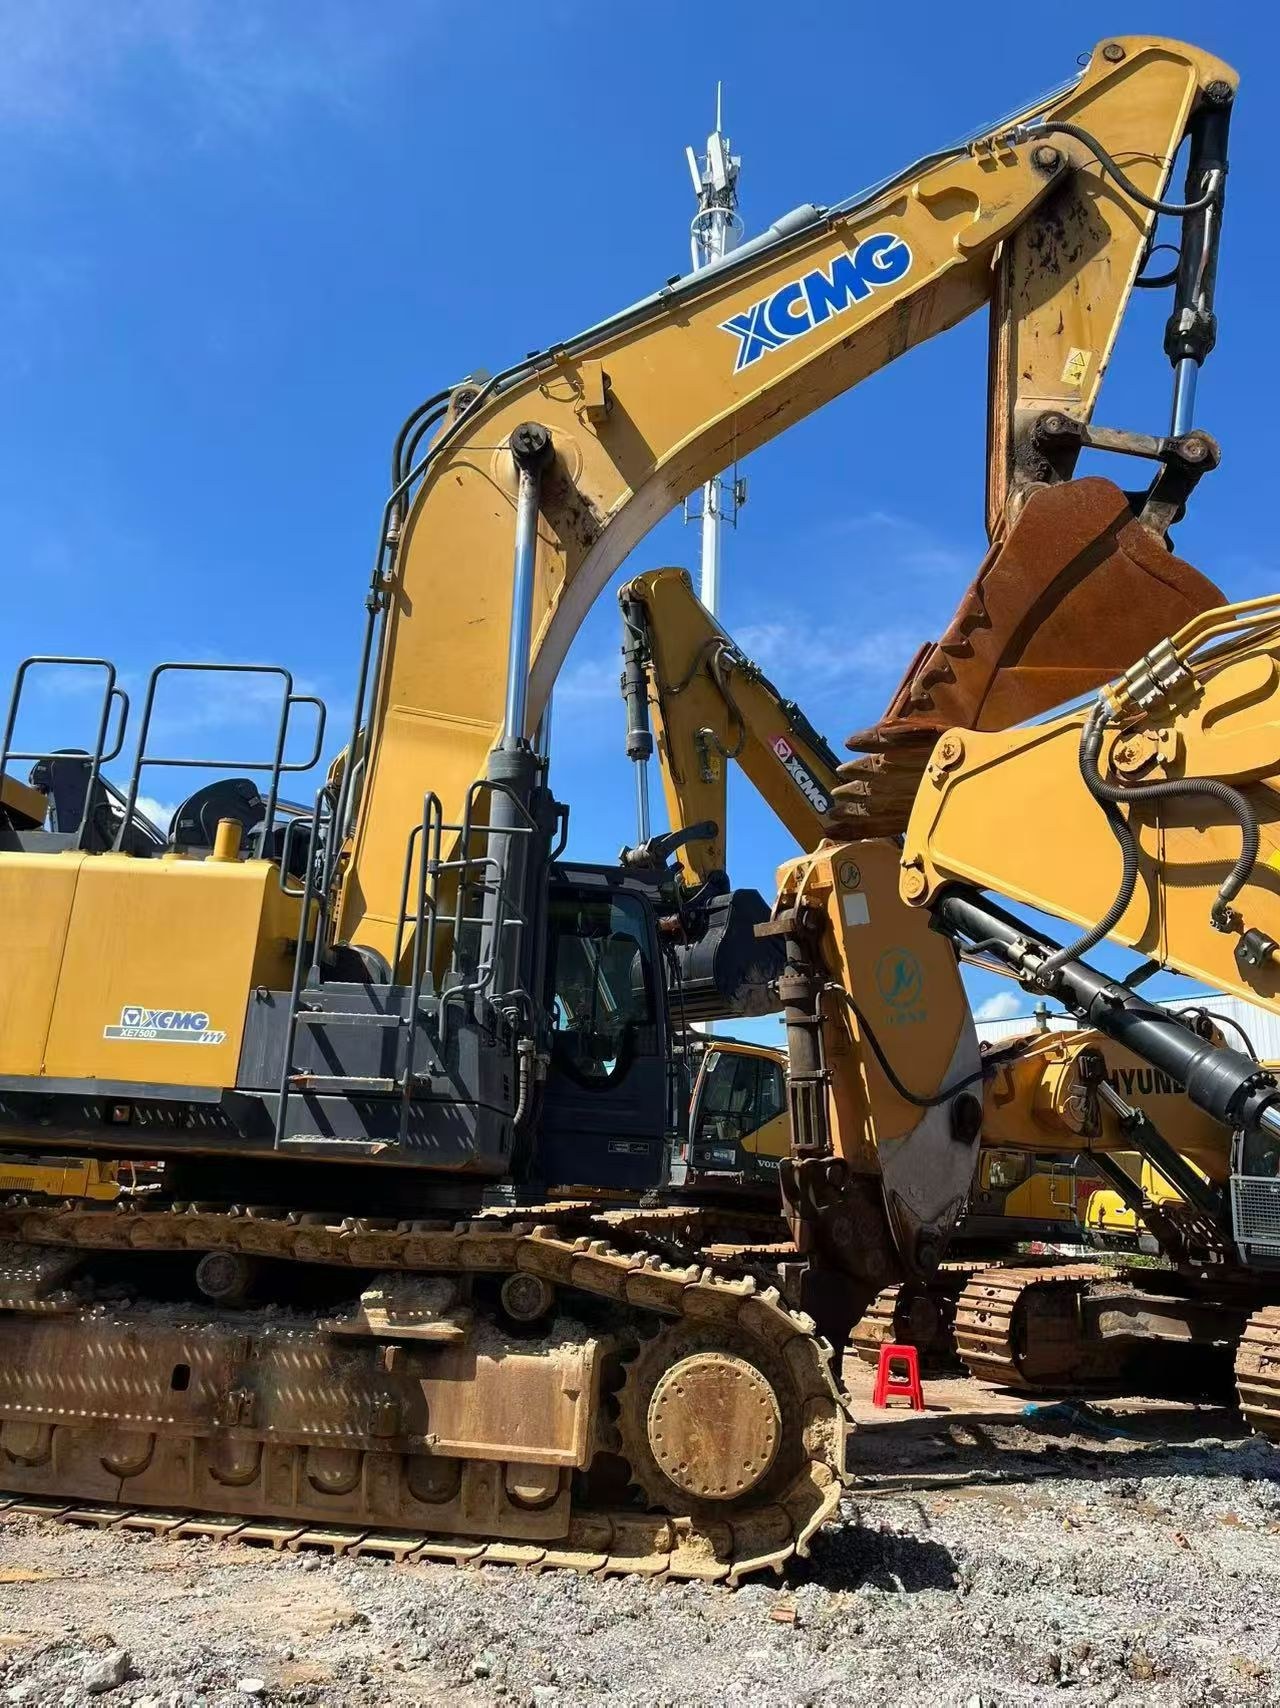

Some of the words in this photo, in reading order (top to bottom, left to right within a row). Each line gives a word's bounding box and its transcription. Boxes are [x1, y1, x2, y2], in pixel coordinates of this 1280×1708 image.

[718, 233, 912, 374] XCMG
[784, 756, 829, 813] XCMG
[120, 1028, 157, 1039] XE750D
[141, 1010, 208, 1031] XCMG
